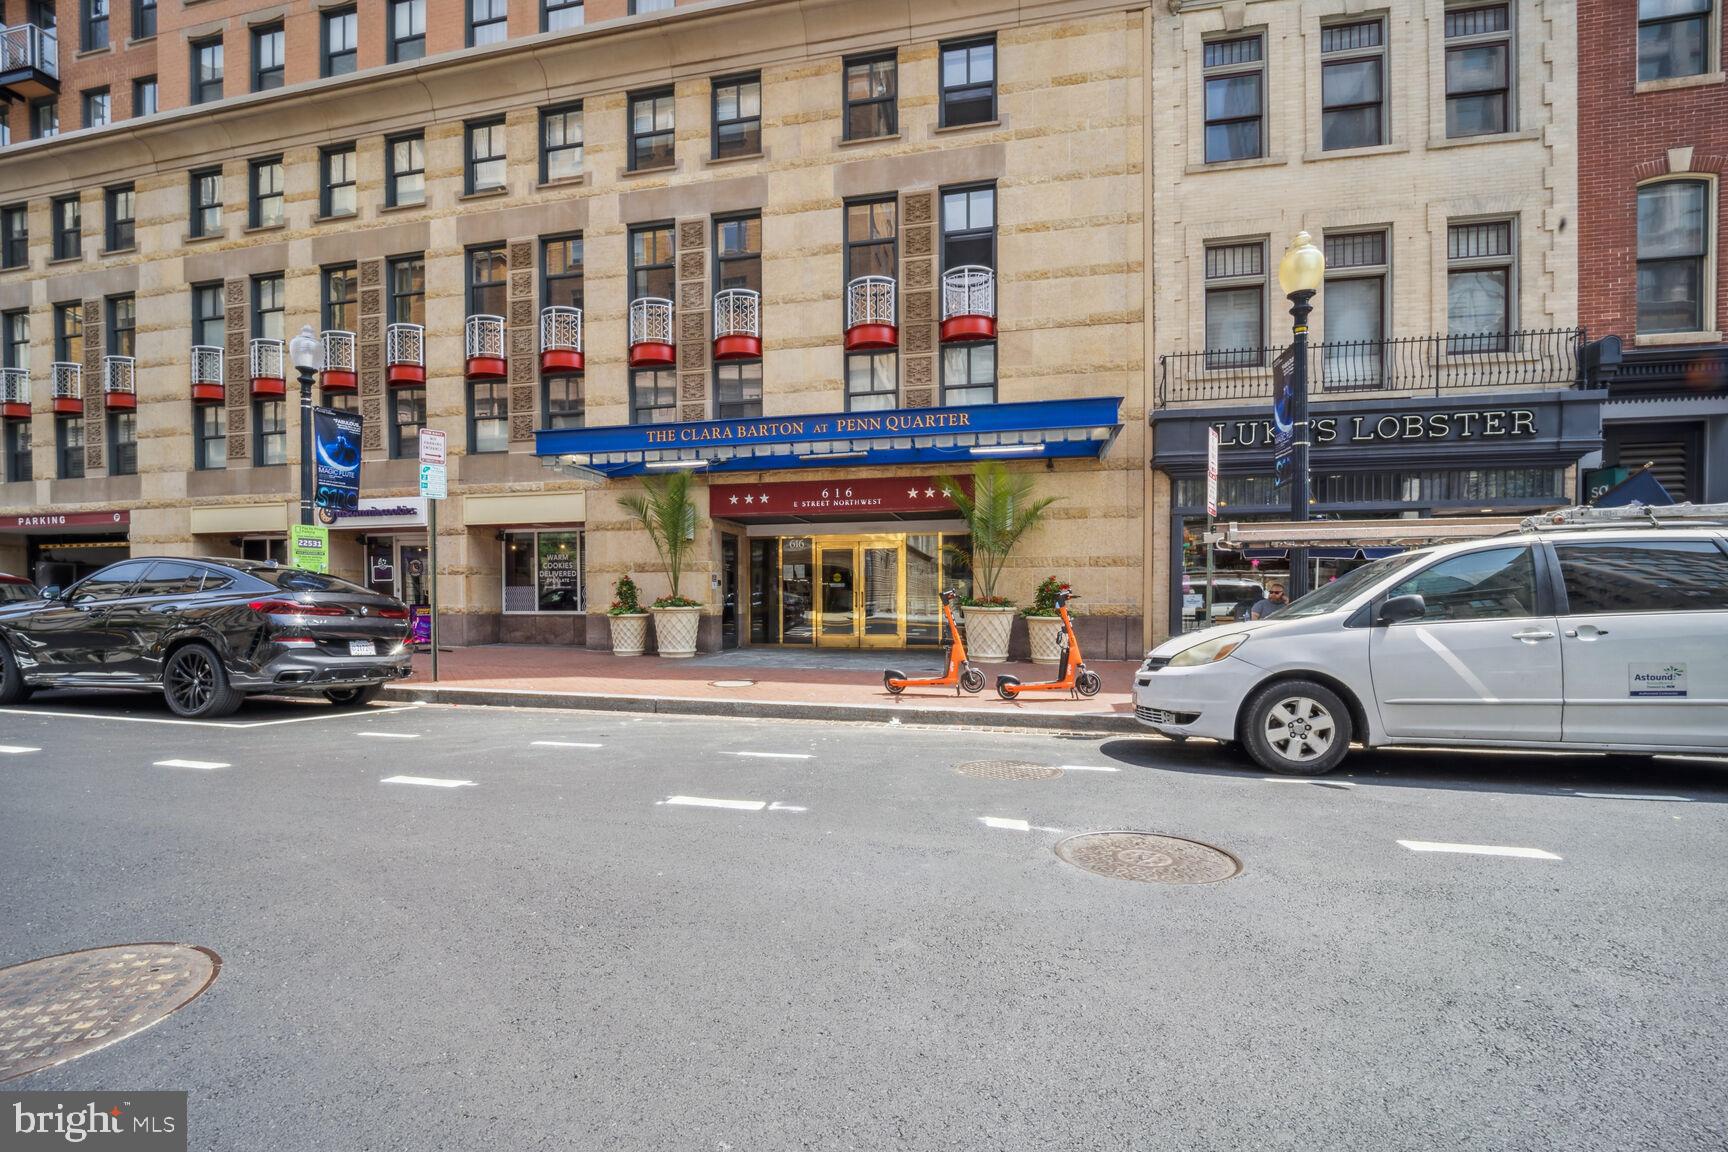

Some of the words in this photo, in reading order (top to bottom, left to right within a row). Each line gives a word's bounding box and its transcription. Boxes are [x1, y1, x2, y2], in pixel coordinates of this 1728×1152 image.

[646, 429, 676, 443] THE
[680, 426, 733, 441] CLARA
[737, 422, 804, 438] BARTON
[813, 424, 828, 433] AT
[836, 417, 882, 432] PENN
[886, 413, 970, 431] QUARTER
[1215, 418, 1338, 446] LUK'S
[1352, 410, 1537, 440] LOBSTER
[318, 467, 339, 476] MAGIC
[833, 498, 882, 506] NORTHWEST
[18, 516, 66, 525] PARKING
[298, 540, 322, 548] 22531
[789, 540, 805, 549] 616
